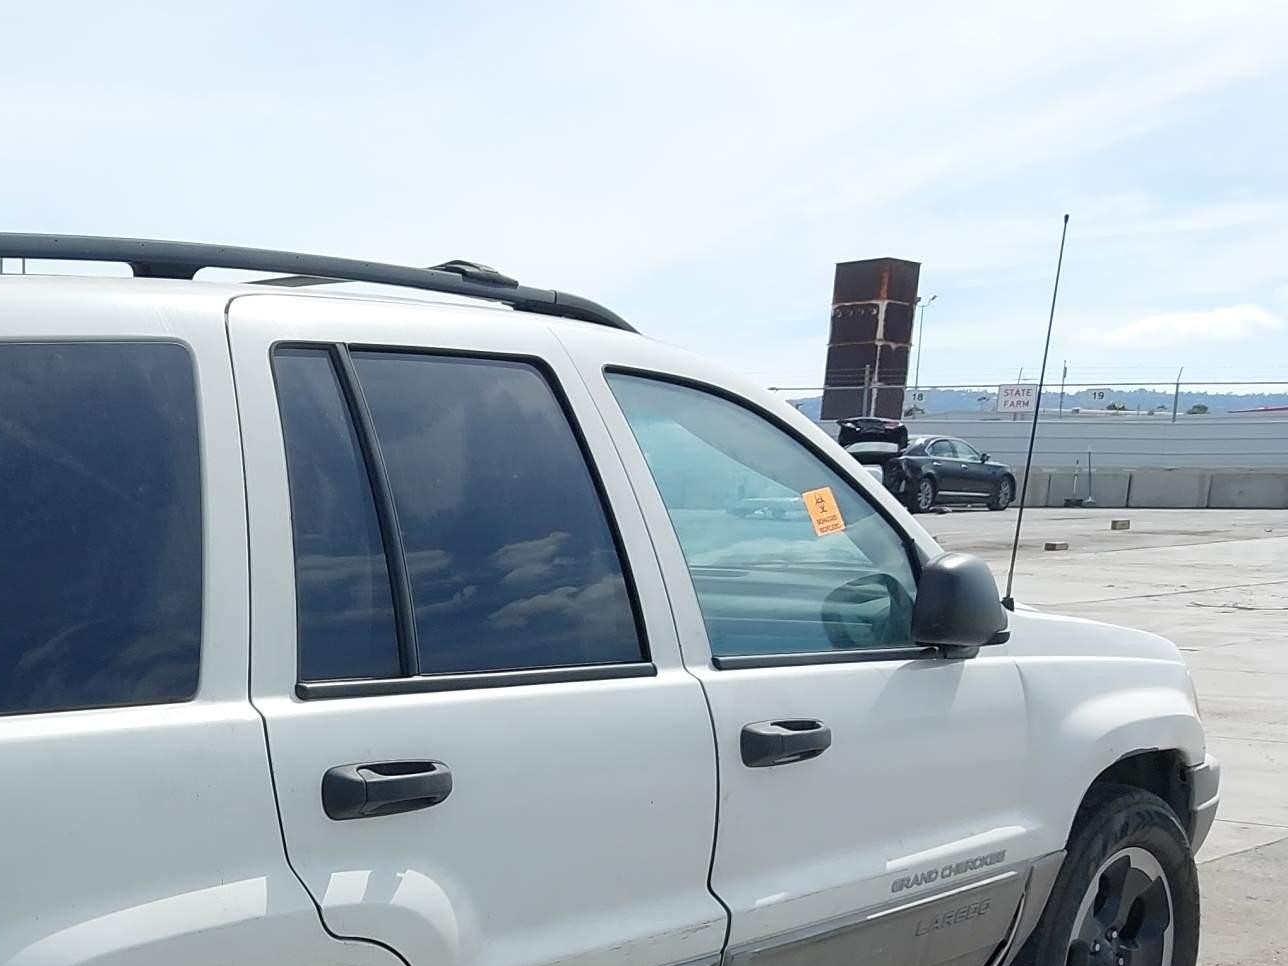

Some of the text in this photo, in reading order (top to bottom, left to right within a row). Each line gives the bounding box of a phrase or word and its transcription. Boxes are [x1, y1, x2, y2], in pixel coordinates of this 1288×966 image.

[1003, 388, 1032, 397] STATE
[1092, 391, 1104, 400] 19
[1003, 400, 1030, 408] FARM
[891, 850, 1006, 893] GRAND CHEROKEE
[915, 899, 992, 937] LAREDO
